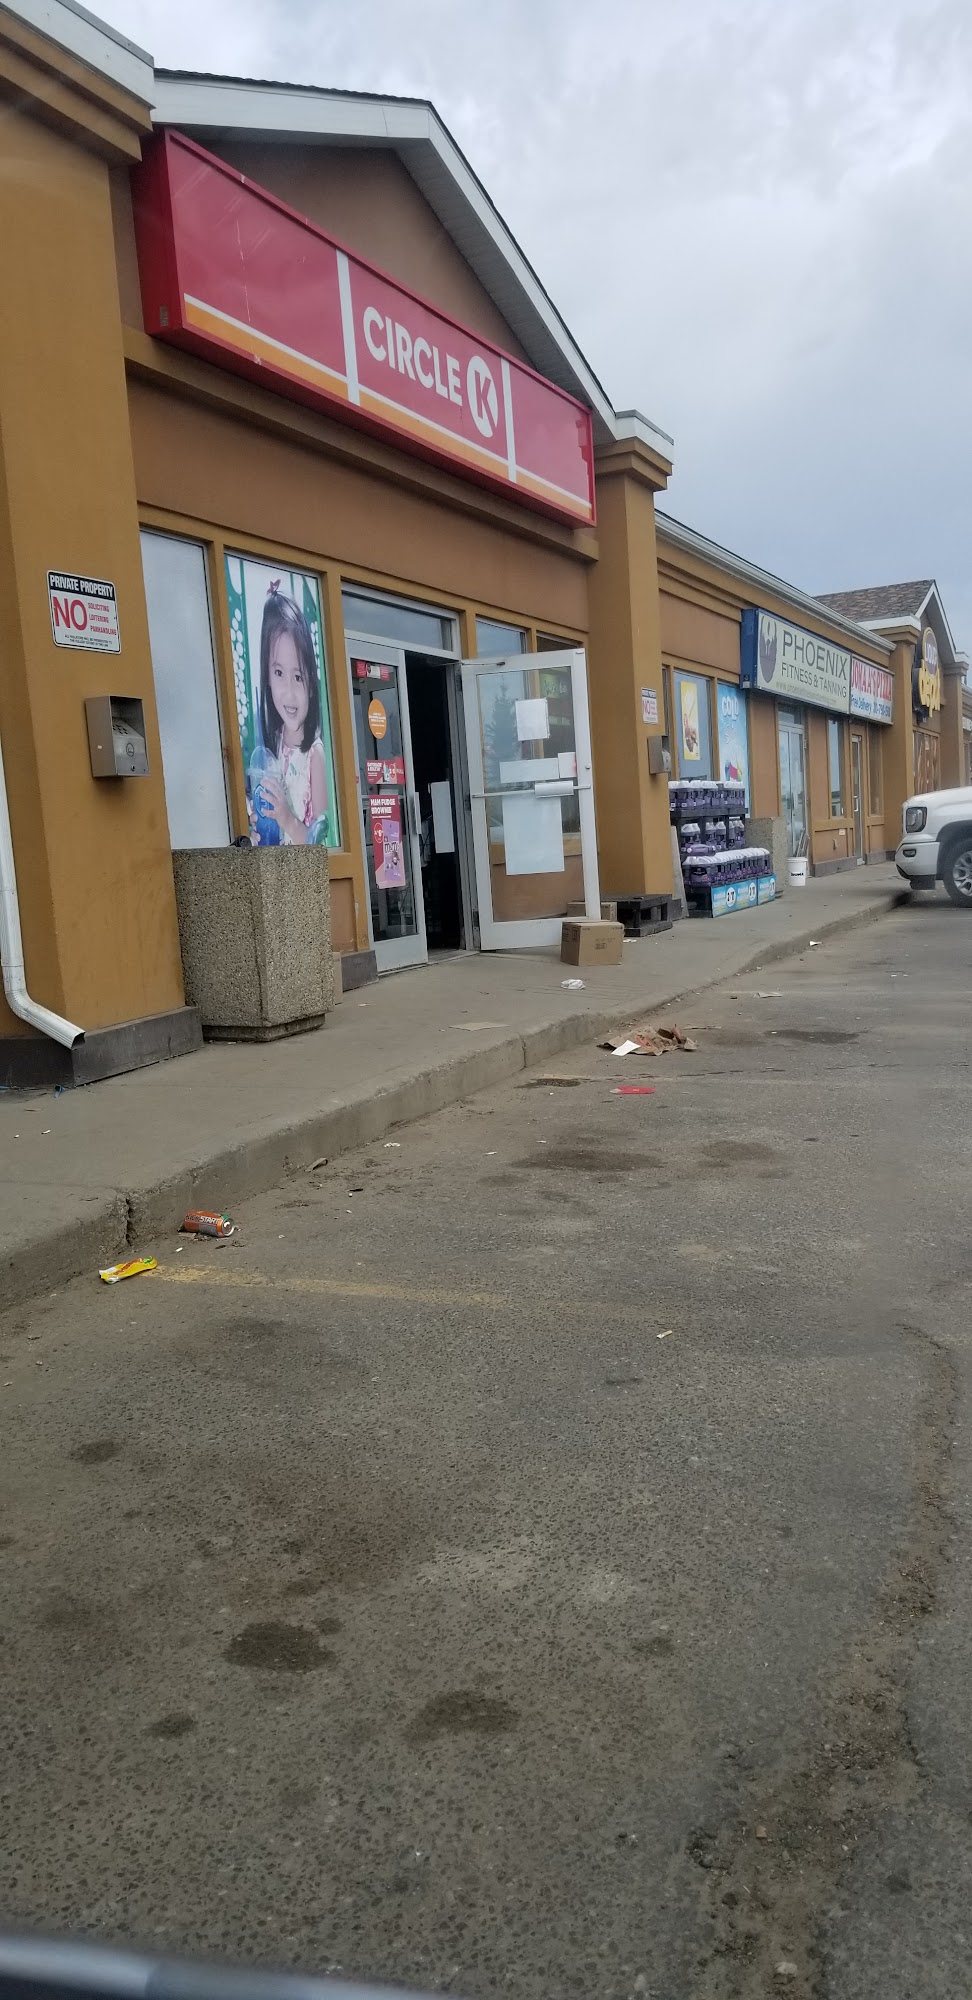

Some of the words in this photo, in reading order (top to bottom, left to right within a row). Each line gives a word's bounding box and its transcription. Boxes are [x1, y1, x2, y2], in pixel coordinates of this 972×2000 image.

[363, 306, 462, 407] CIRCLE
[470, 357, 498, 438] K
[49, 574, 79, 591] PRIVATE
[80, 580, 113, 598] PROPERTY
[53, 596, 88, 631] NO
[88, 602, 110, 613] SOLICITING
[89, 614, 109, 623] LOITERING
[90, 625, 117, 636] PANHANDLING
[782, 629, 848, 681] PHOENIX
[781, 661, 812, 686] FITNESS
[813, 674, 818, 688] &
[819, 676, 847, 698] TANNING
[371, 806, 392, 814] BROWNIE
